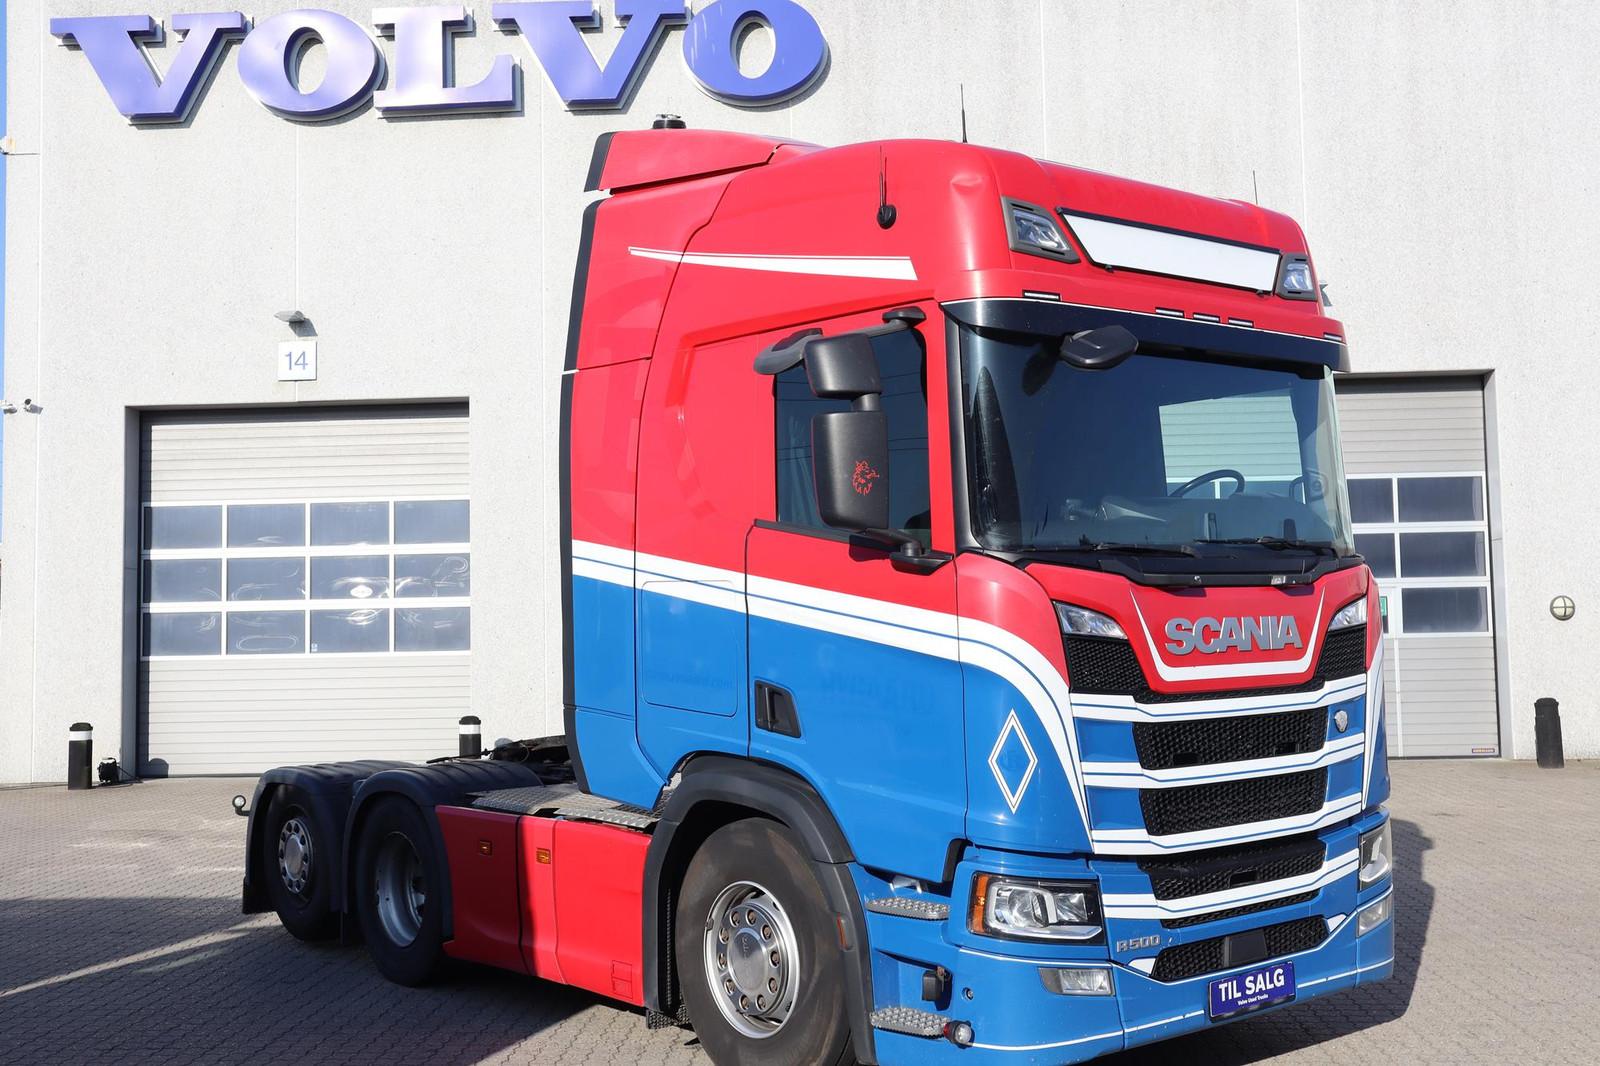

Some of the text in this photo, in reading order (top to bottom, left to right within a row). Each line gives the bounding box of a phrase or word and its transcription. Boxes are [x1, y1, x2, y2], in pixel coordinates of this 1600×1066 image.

[50, 0, 826, 125] VOLVO
[284, 351, 308, 371] 14
[1164, 614, 1303, 656] SCANIA
[1116, 934, 1161, 953] R500
[1218, 968, 1285, 1002] TIL SALG
